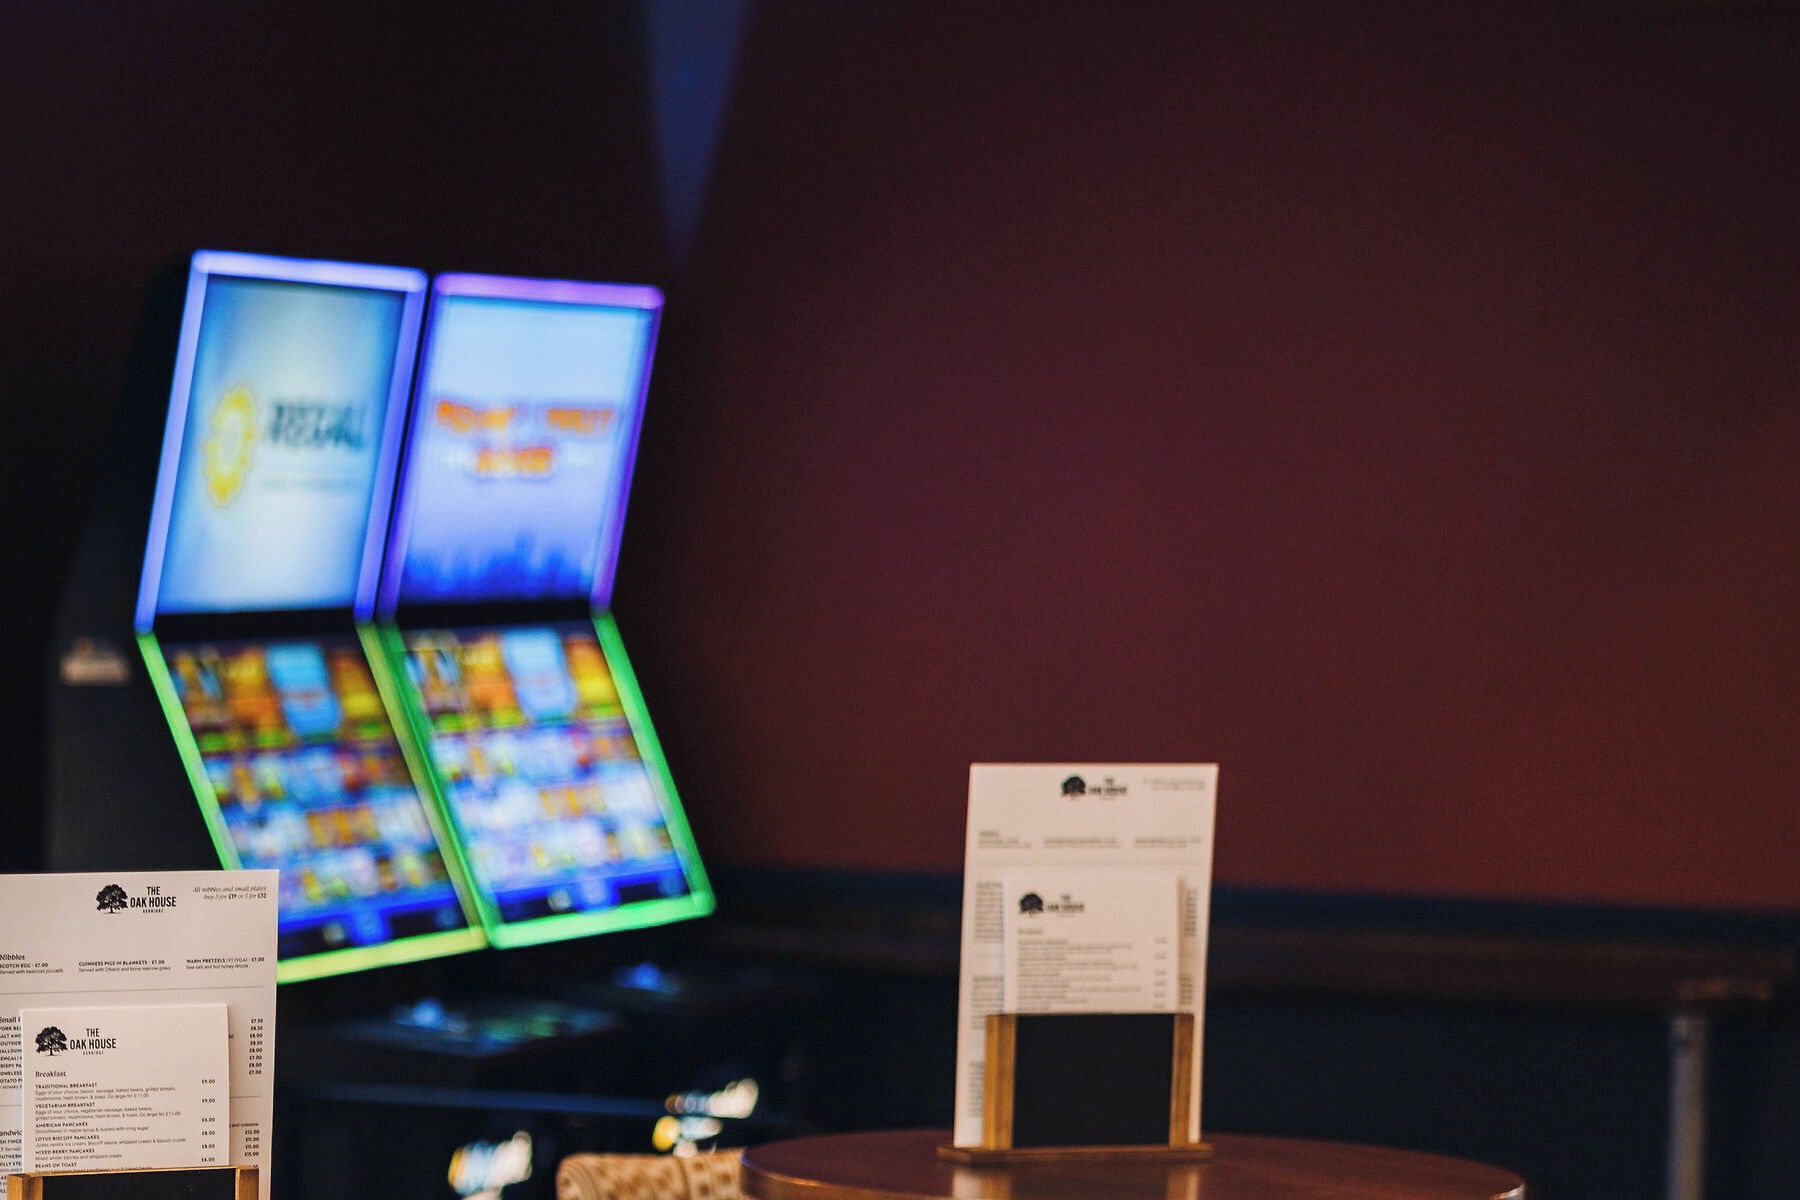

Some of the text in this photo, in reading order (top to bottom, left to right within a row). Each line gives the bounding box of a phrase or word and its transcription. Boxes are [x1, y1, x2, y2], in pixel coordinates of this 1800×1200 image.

[146, 886, 161, 896] THE
[130, 896, 177, 908] OAK HOUSE
[86, 1028, 100, 1037] THE
[70, 1038, 117, 1050] OAK HOUSE
